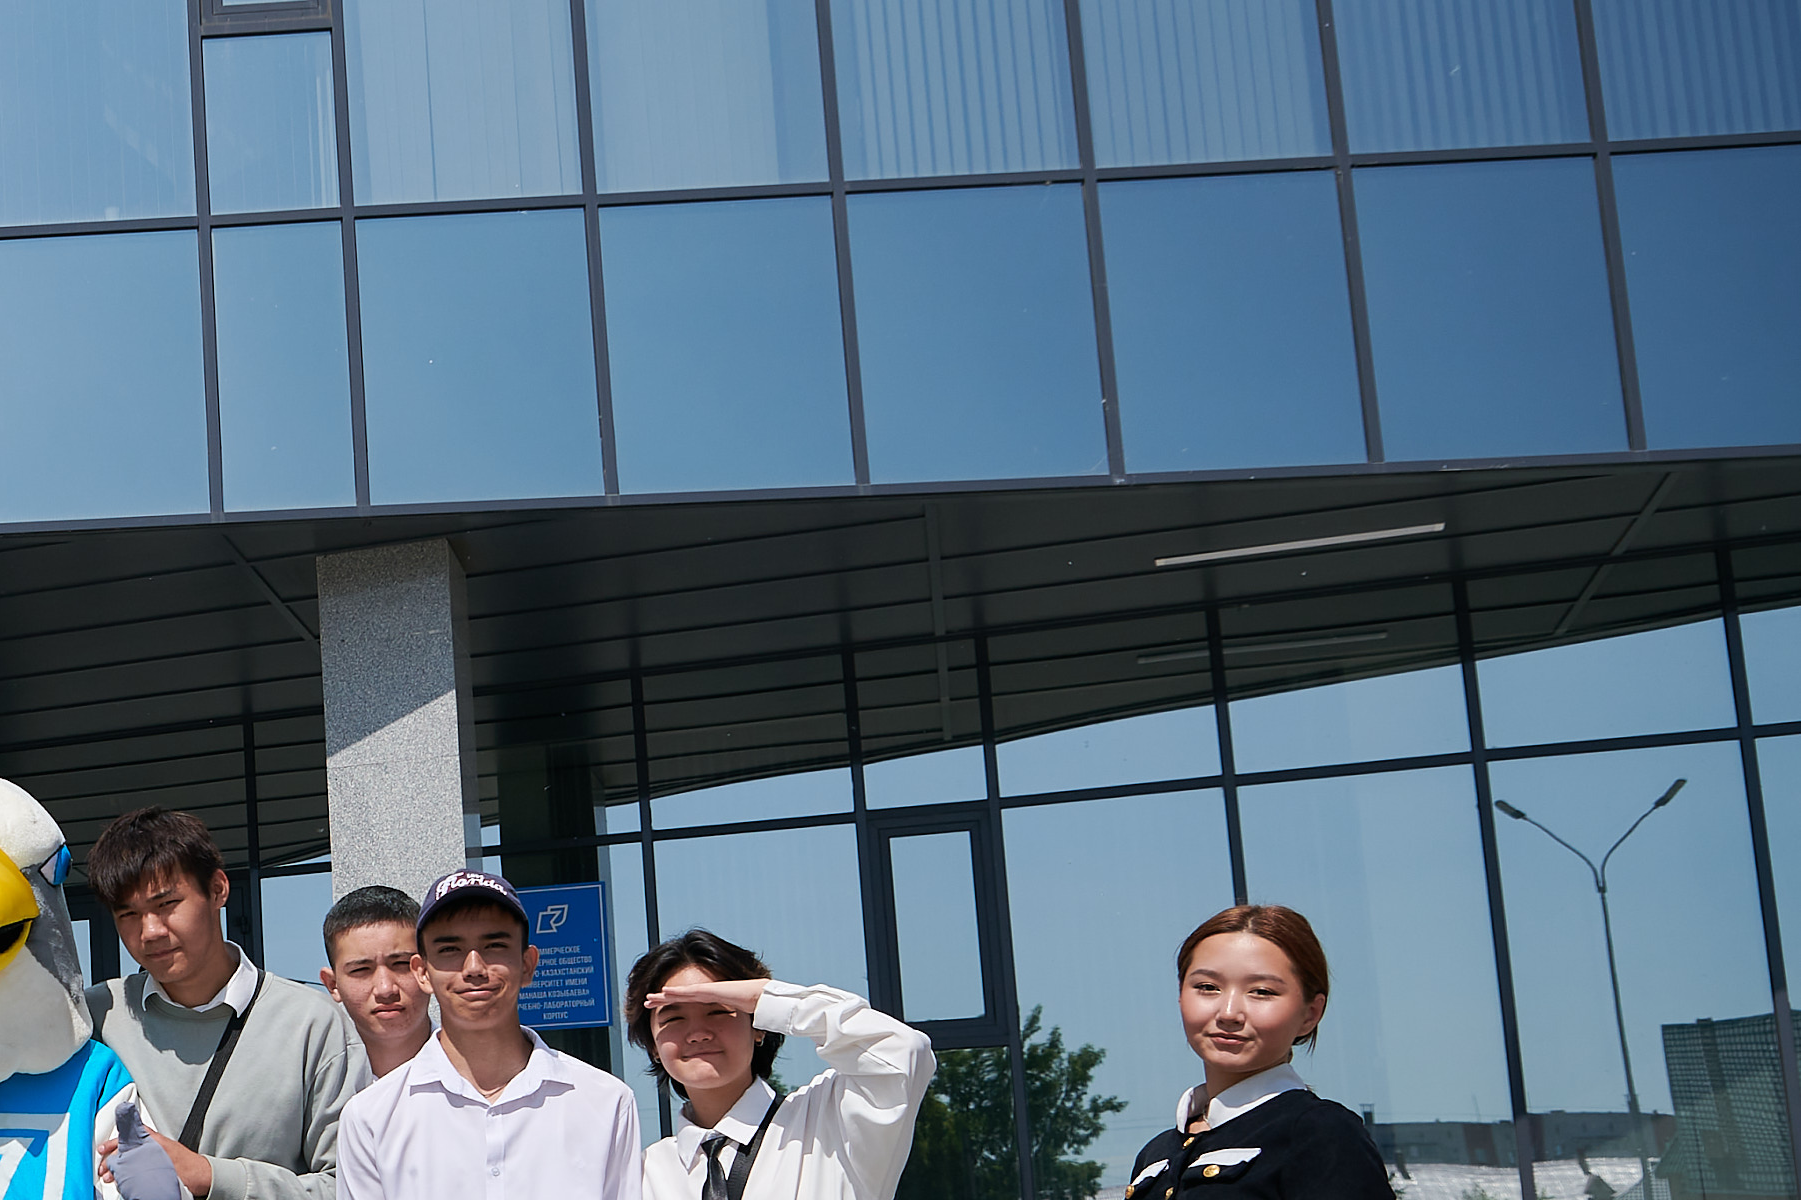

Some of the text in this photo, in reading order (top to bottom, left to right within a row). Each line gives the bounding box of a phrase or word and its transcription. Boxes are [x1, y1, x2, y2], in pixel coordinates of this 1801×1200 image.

[538, 945, 581, 955] ММЕРЧЕСКОЕ
[558, 955, 592, 965] ОБЩЕСТВО
[534, 965, 594, 978] О-КАЗАХСТАНСКИЙ
[521, 977, 588, 989] ИВЕРСИТЕТ ИМЕНИ
[543, 1011, 569, 1020] КОРПУС
